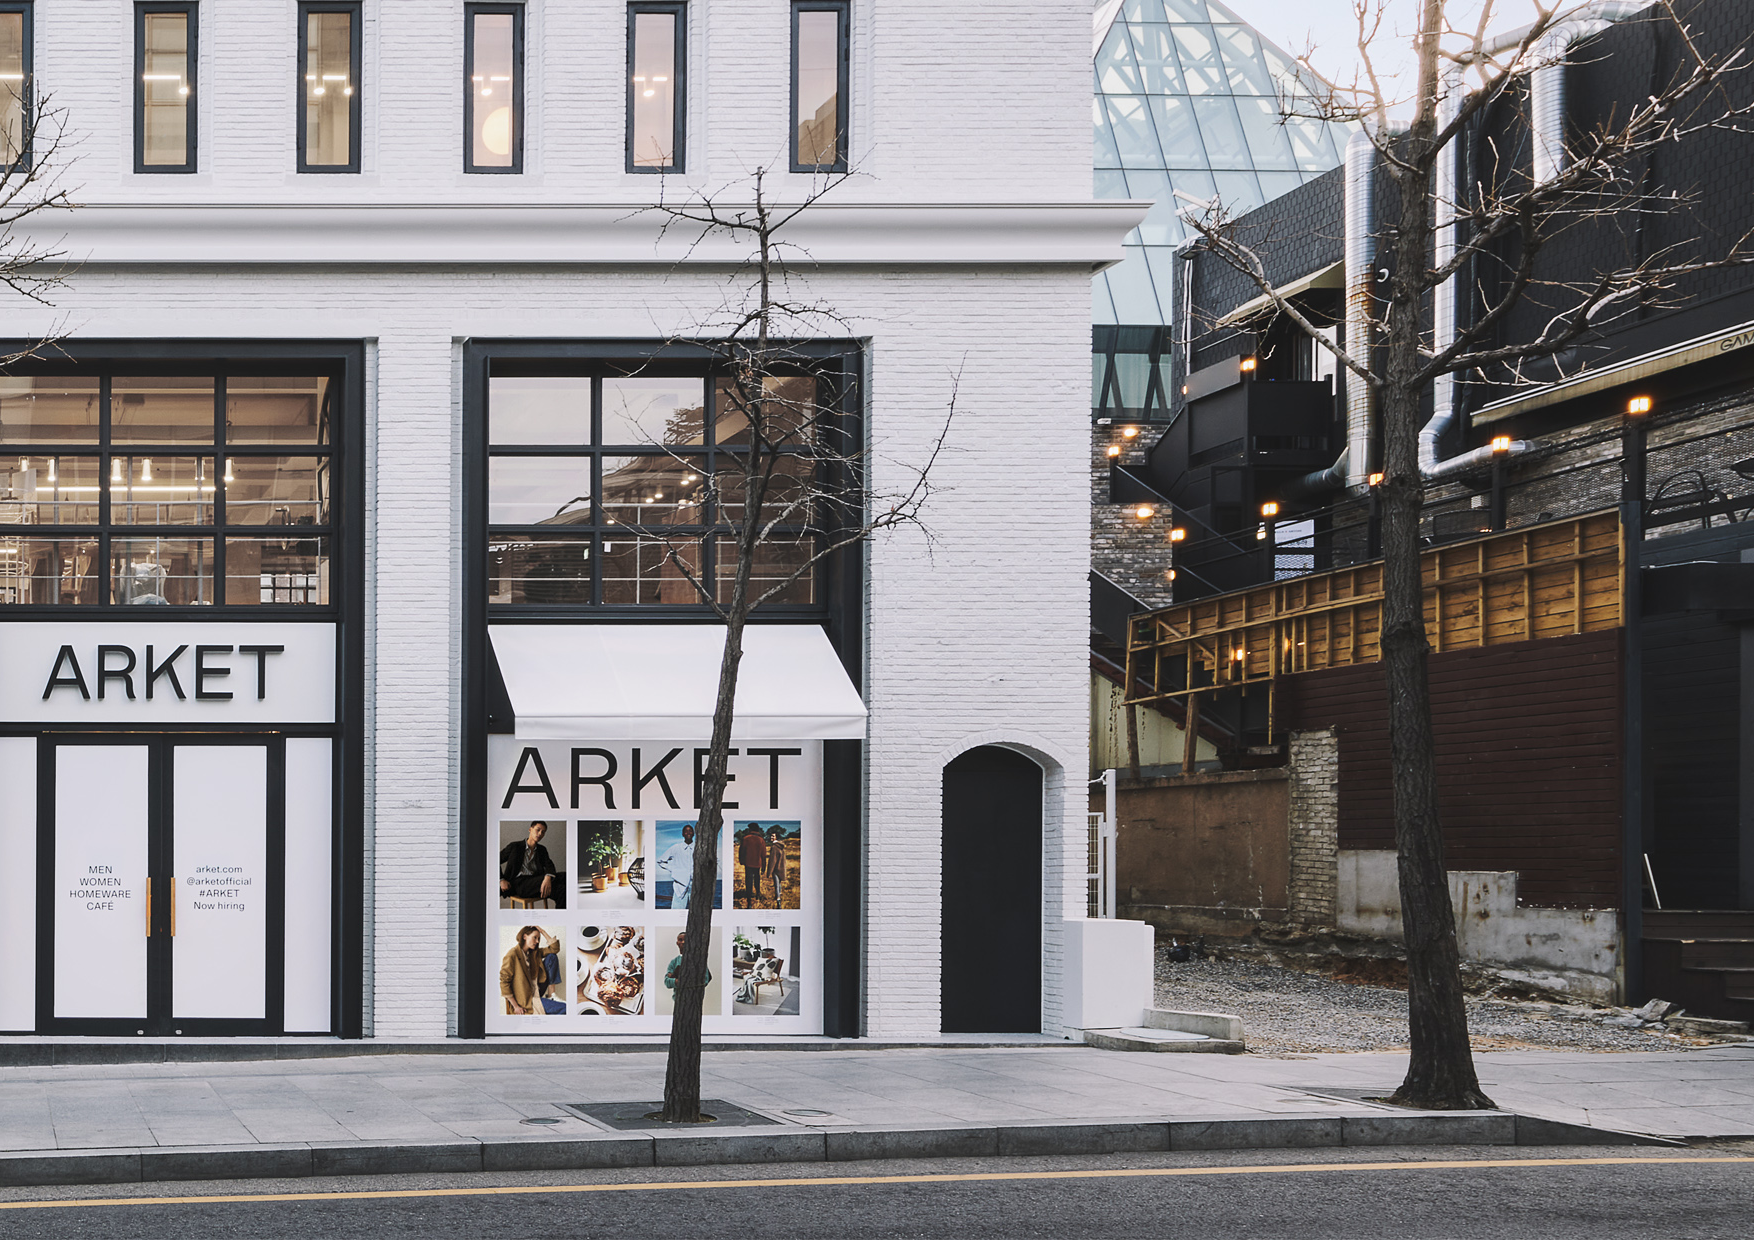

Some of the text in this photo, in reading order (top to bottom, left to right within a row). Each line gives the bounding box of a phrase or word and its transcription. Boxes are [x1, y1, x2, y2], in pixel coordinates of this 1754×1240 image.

[42, 644, 285, 700] ARKET
[501, 747, 802, 810] ARKET
[88, 865, 113, 874] MEN
[195, 865, 243, 874] arket.com
[79, 877, 122, 887] WOMEN
[186, 877, 252, 887] @arketofficial
[69, 890, 131, 899] HOMEWARE
[199, 889, 240, 898] #ARKET
[86, 901, 114, 911] CAFÉ
[193, 901, 245, 912] Now hiring
